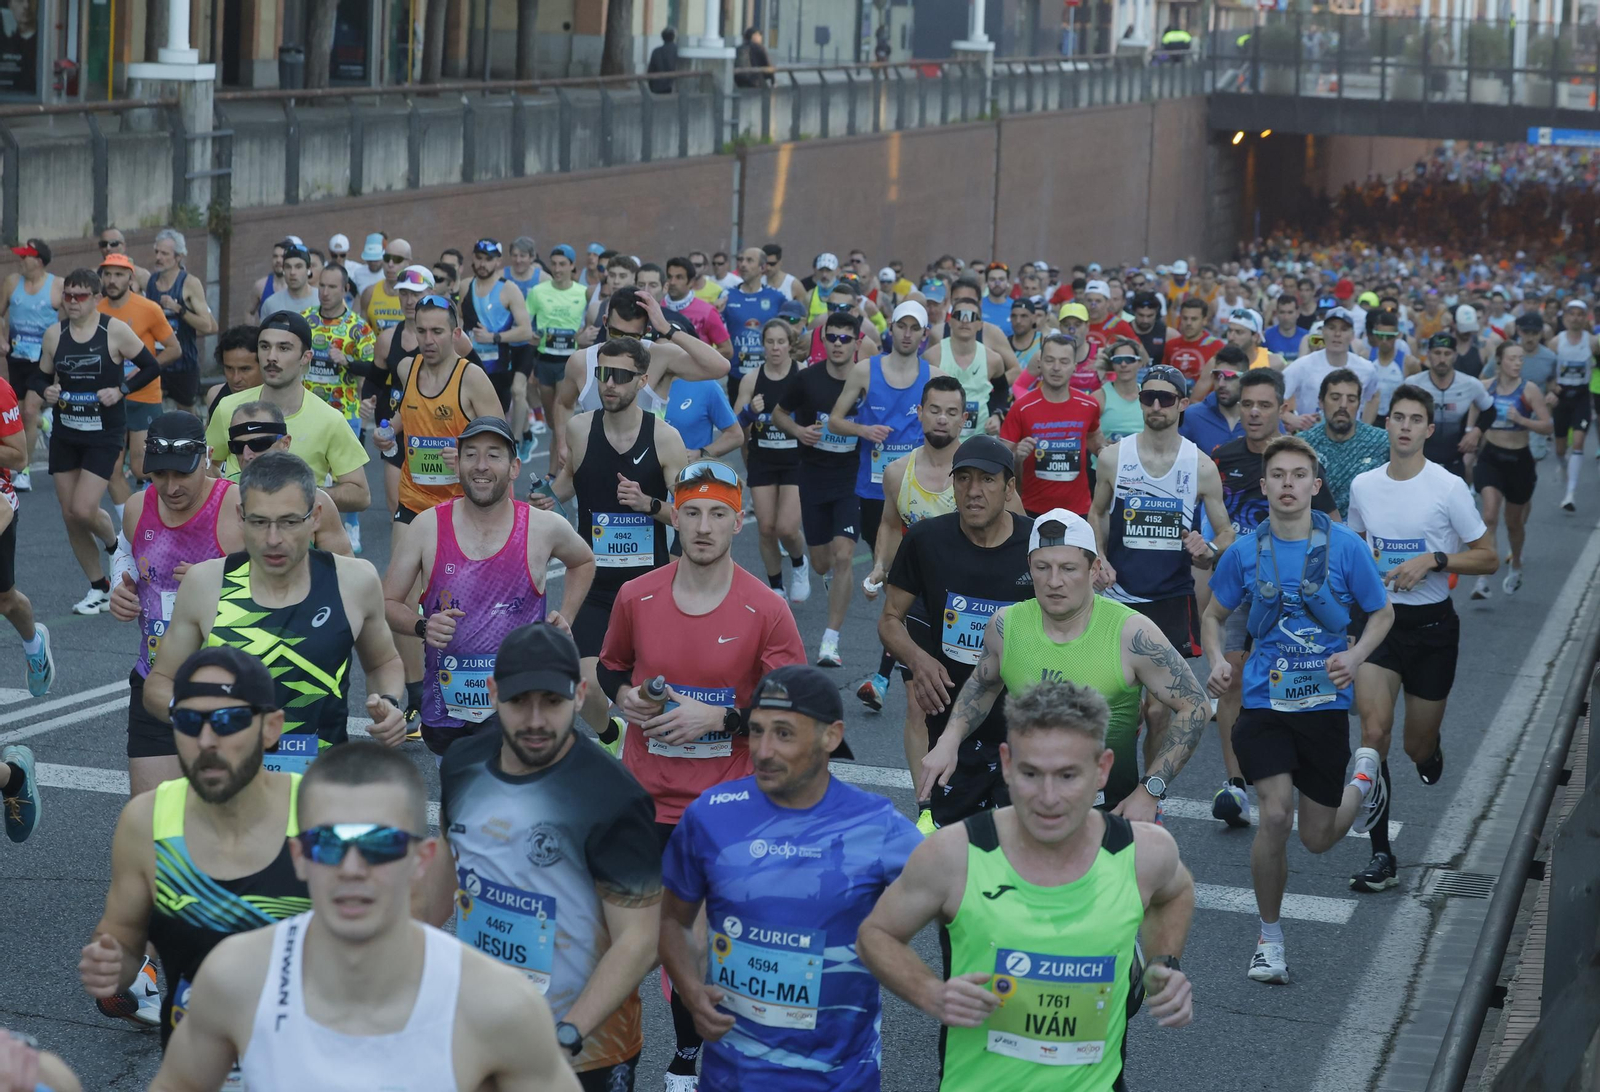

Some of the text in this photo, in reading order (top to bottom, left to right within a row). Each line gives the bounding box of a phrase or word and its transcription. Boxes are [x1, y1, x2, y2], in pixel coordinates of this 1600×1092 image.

[766, 432, 786, 440] YARA
[825, 434, 847, 443] FRAN
[422, 439, 450, 447] ZURICH
[423, 453, 439, 461] 2709
[421, 463, 443, 473] IVAN
[1046, 462, 1070, 471] JOHN
[1144, 501, 1177, 509] ZURICH
[613, 516, 646, 524] ZURICH
[1144, 515, 1162, 523] 4152
[614, 532, 632, 540] 4942
[608, 542, 638, 554] HUGO
[1386, 542, 1419, 550] ZURICH
[971, 602, 999, 613] ZURI
[462, 659, 496, 667] ZURIC
[464, 679, 486, 689] 4640
[1293, 676, 1312, 684] 6294
[1285, 684, 1321, 699] MARK
[709, 790, 750, 805] HOKA
[768, 842, 797, 860] edp
[486, 886, 544, 912] ZURICH
[485, 916, 514, 935] 4467
[748, 927, 811, 949] ZURICH
[474, 930, 527, 964] JESUS
[278, 925, 299, 1006] ERWAN
[747, 956, 779, 975] 4594
[1038, 961, 1103, 977] ZURICH
[718, 966, 810, 1005] AL-CI-MA
[1037, 993, 1071, 1009] 1761
[1025, 1011, 1077, 1038] IVÁN
